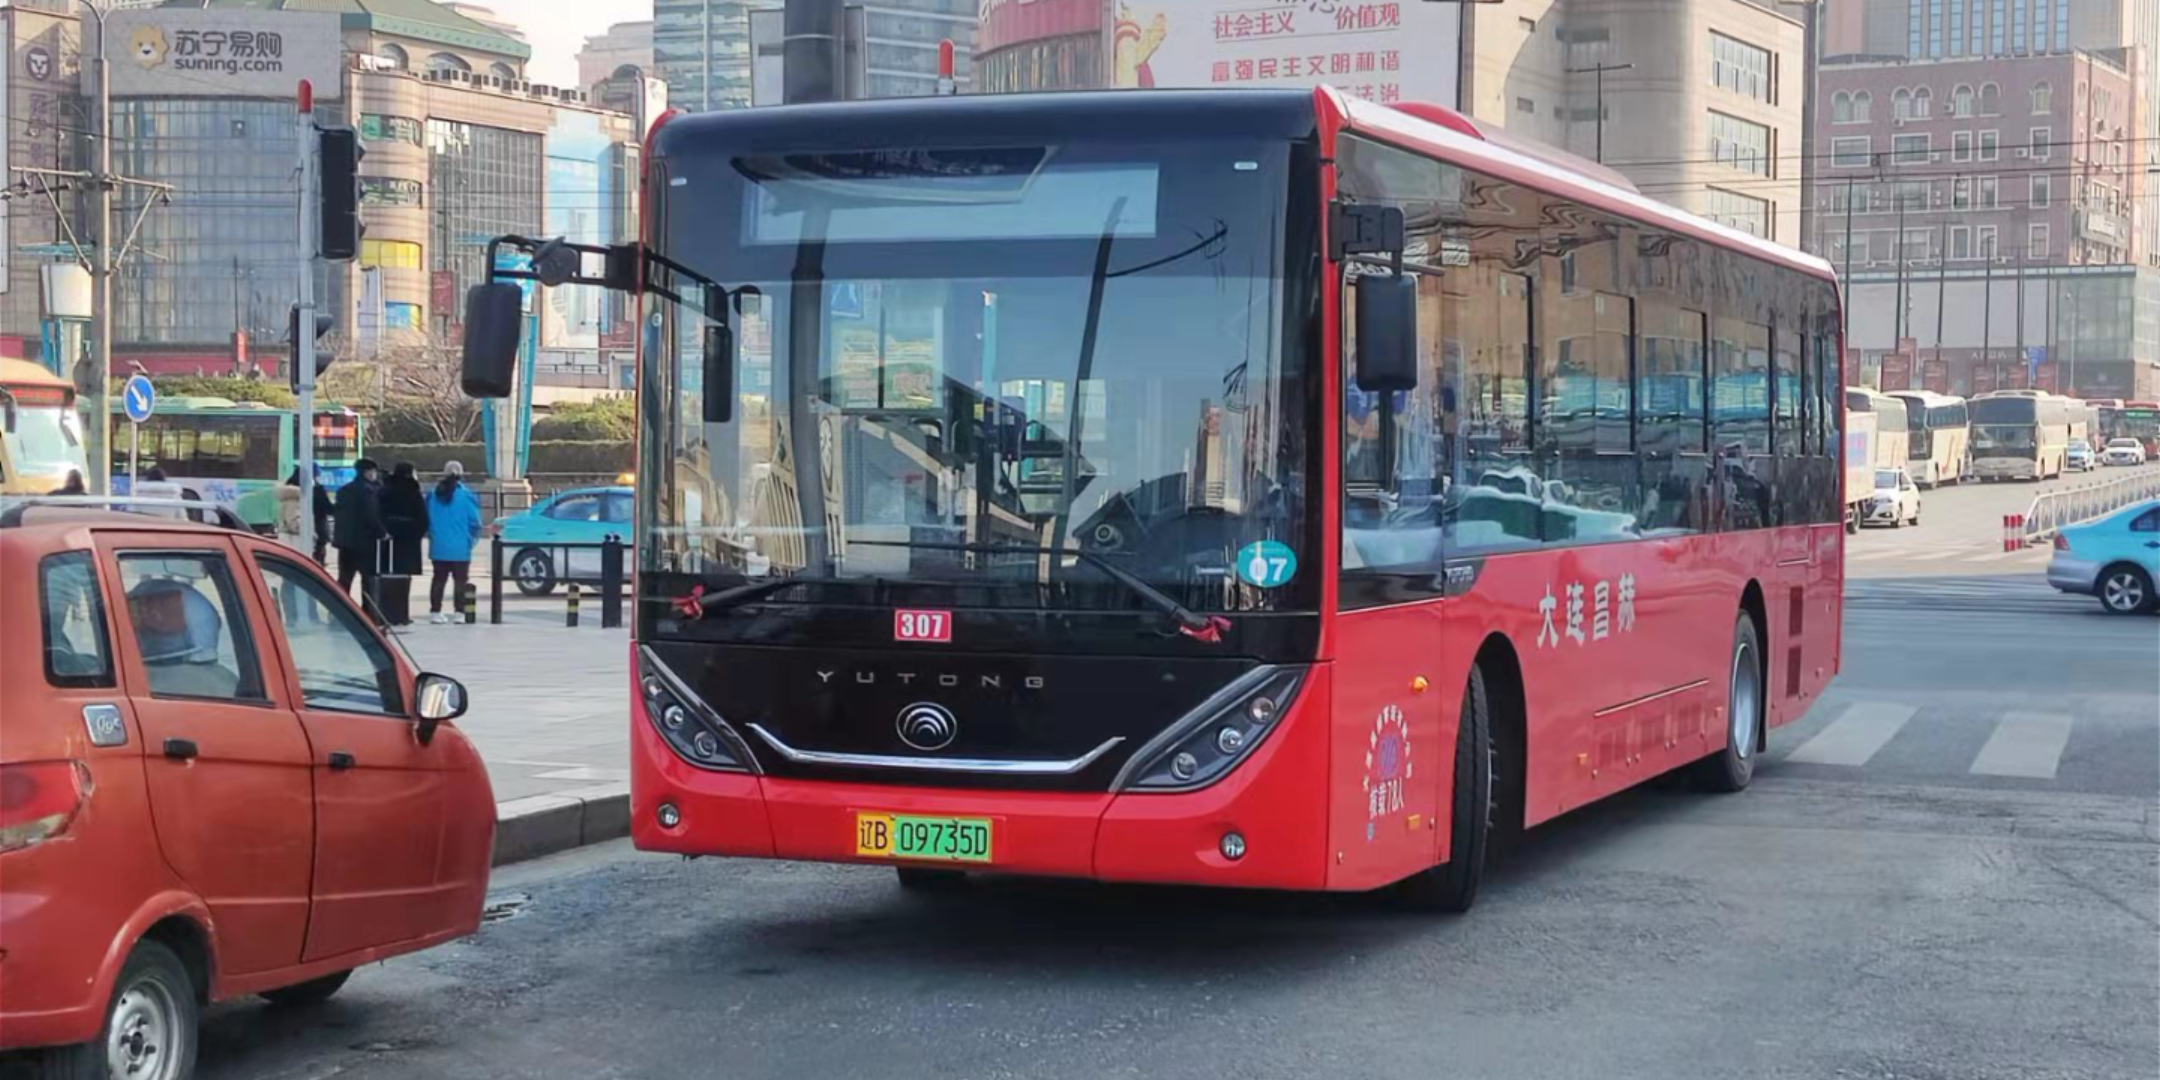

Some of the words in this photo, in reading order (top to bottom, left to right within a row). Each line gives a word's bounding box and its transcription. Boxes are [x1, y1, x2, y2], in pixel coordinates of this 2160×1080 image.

[1211, 10, 1296, 39] 社会主义
[1334, 3, 1400, 31] 价值观
[174, 30, 283, 58] 苏宁易购
[174, 58, 283, 75] suning.com
[1249, 557, 1288, 582] 07
[901, 613, 943, 638] 307
[817, 670, 1043, 689] YUTONG
